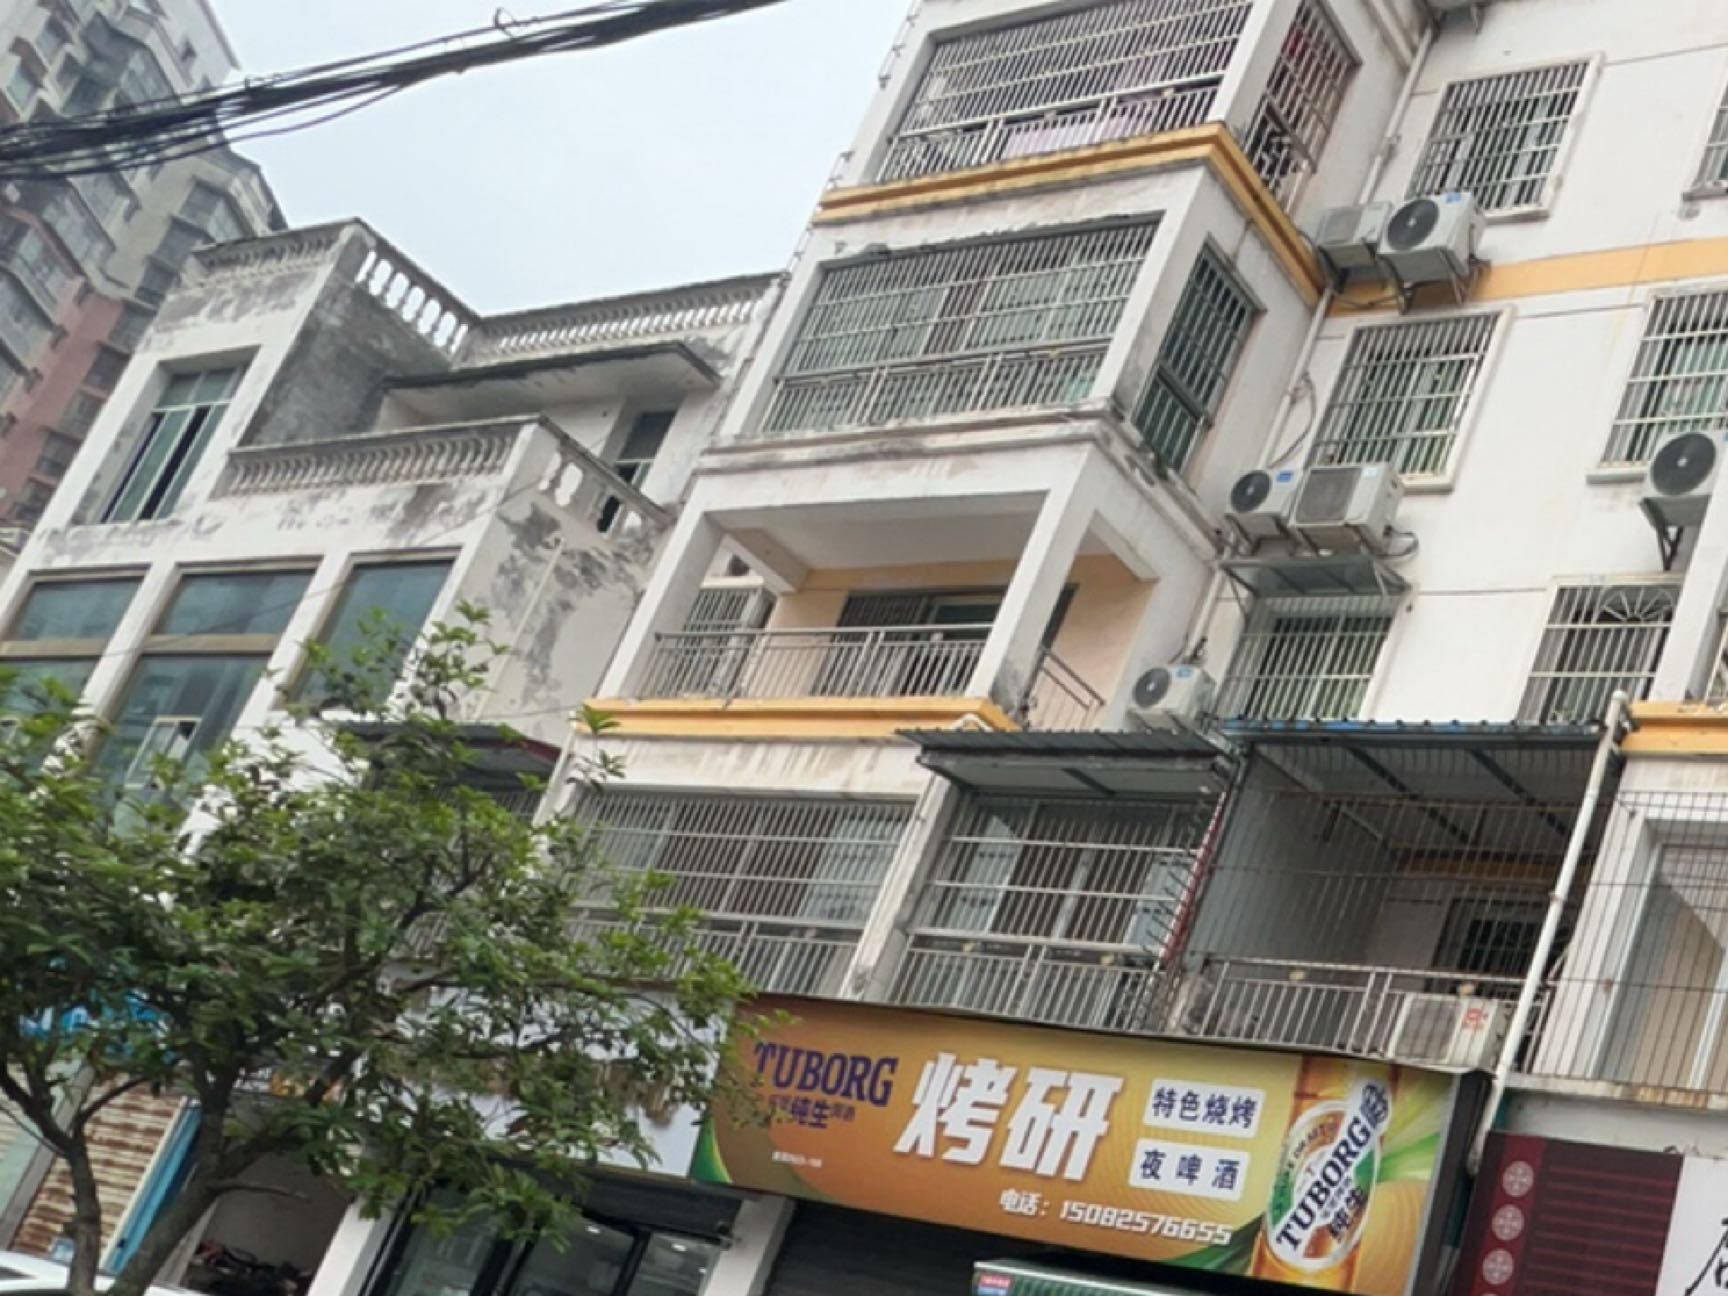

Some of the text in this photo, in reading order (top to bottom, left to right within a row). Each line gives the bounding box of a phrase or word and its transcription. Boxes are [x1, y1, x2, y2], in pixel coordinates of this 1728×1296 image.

[753, 1041, 898, 1107] TUBORG
[1152, 1086, 1258, 1128] 特色烧烤
[893, 1052, 1124, 1182] 烤研
[1139, 1148, 1242, 1191] 夜啤酒
[1276, 1114, 1371, 1250] TUBORG
